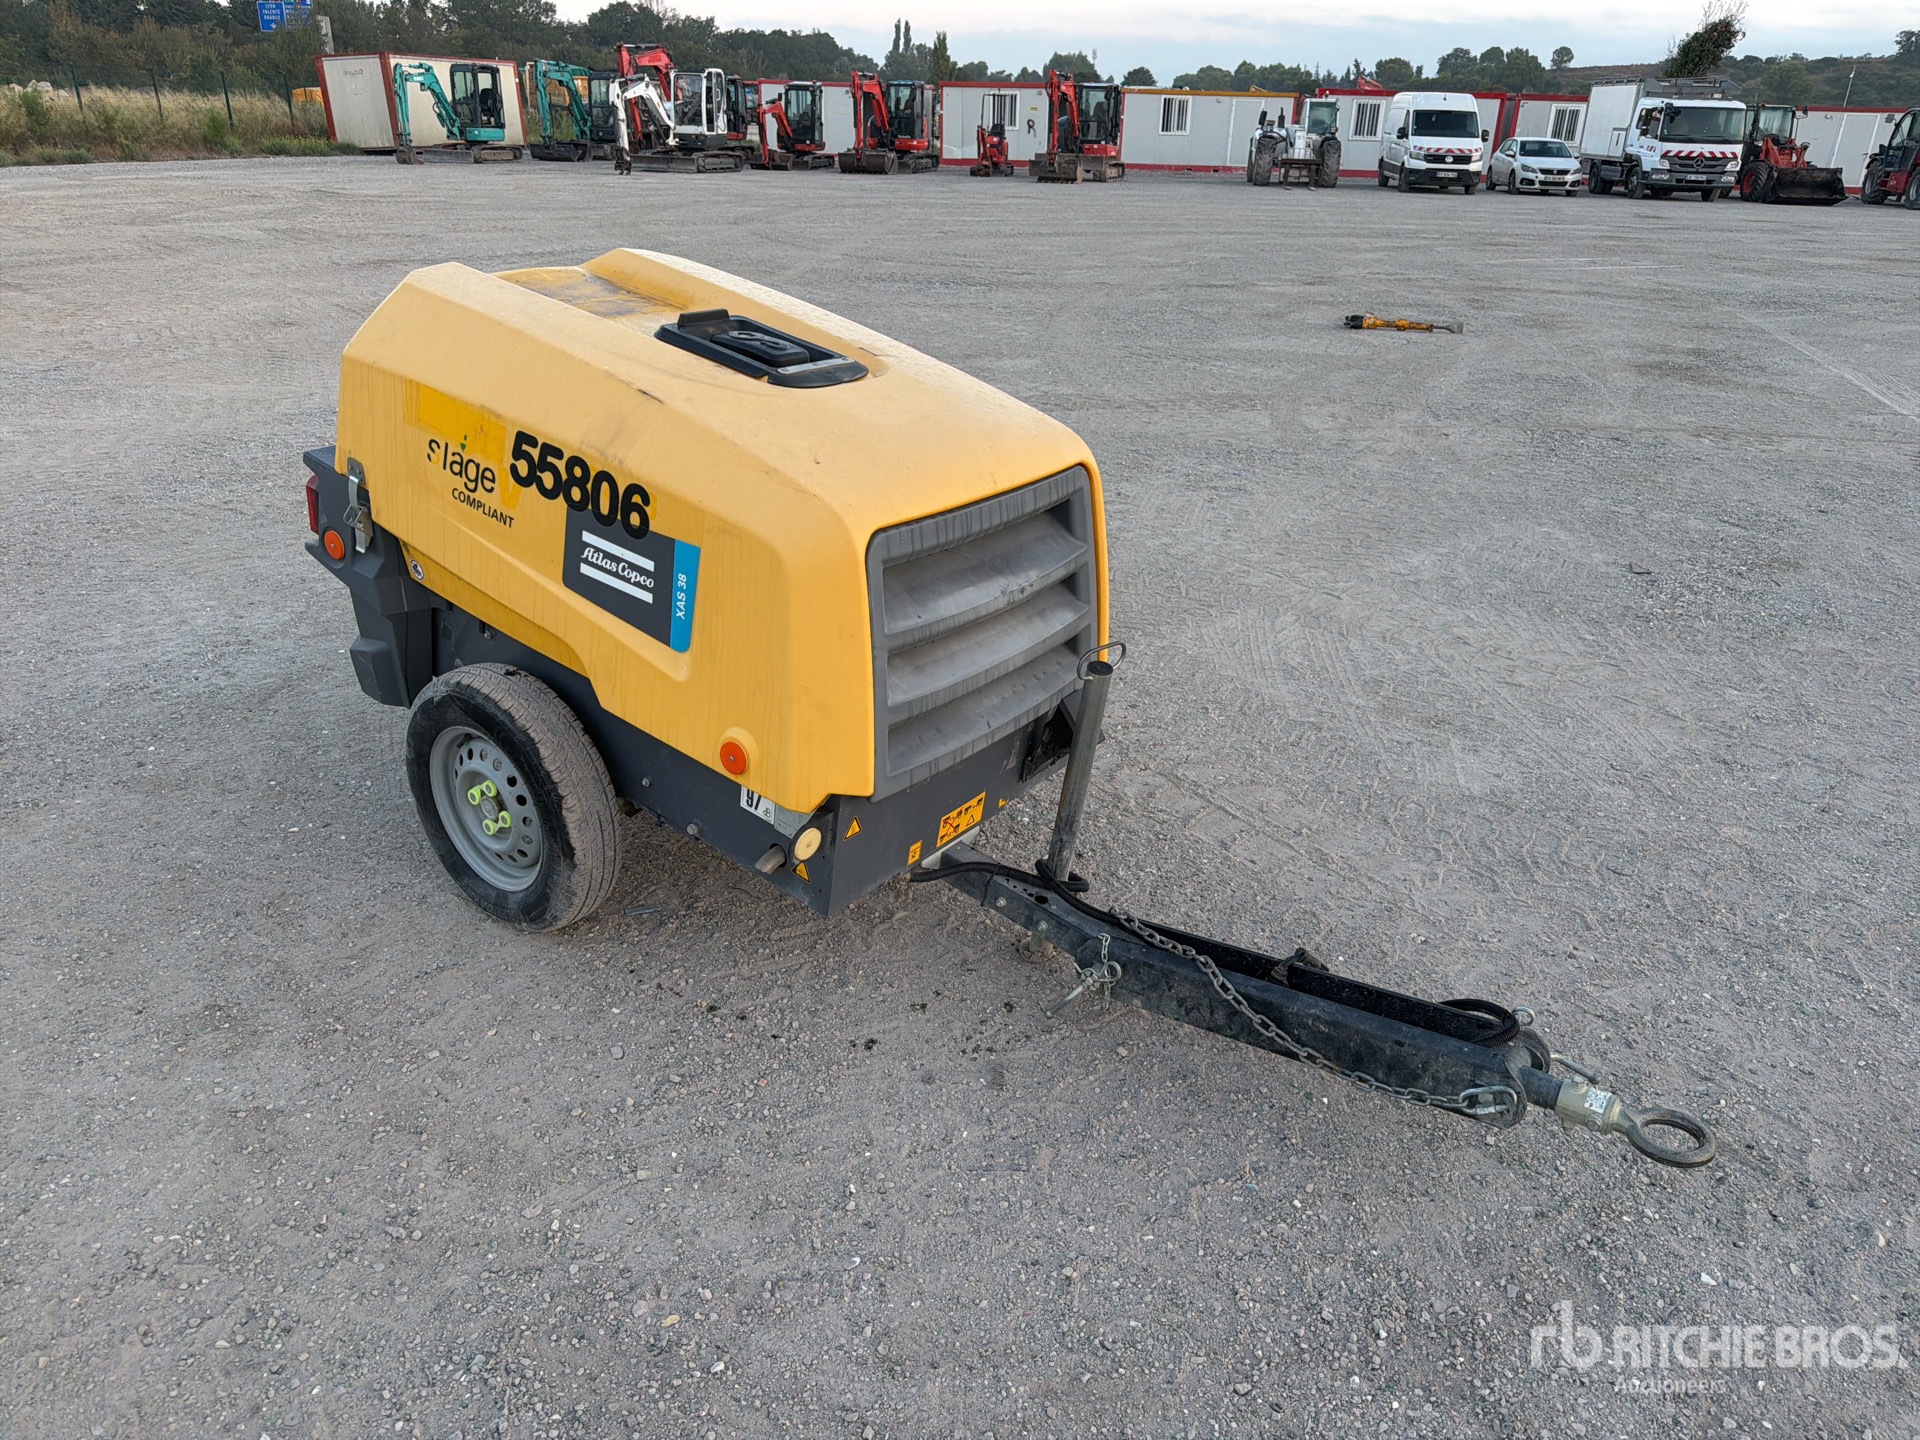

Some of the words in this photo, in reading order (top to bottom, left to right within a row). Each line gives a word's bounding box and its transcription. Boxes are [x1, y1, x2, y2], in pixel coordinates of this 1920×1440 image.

[509, 430, 651, 540] 55806
[451, 487, 515, 529] COMPLIANT
[580, 546, 617, 572] Atlas
[617, 561, 655, 588] Copco
[677, 573, 687, 590] 38
[676, 591, 686, 620] XAS
